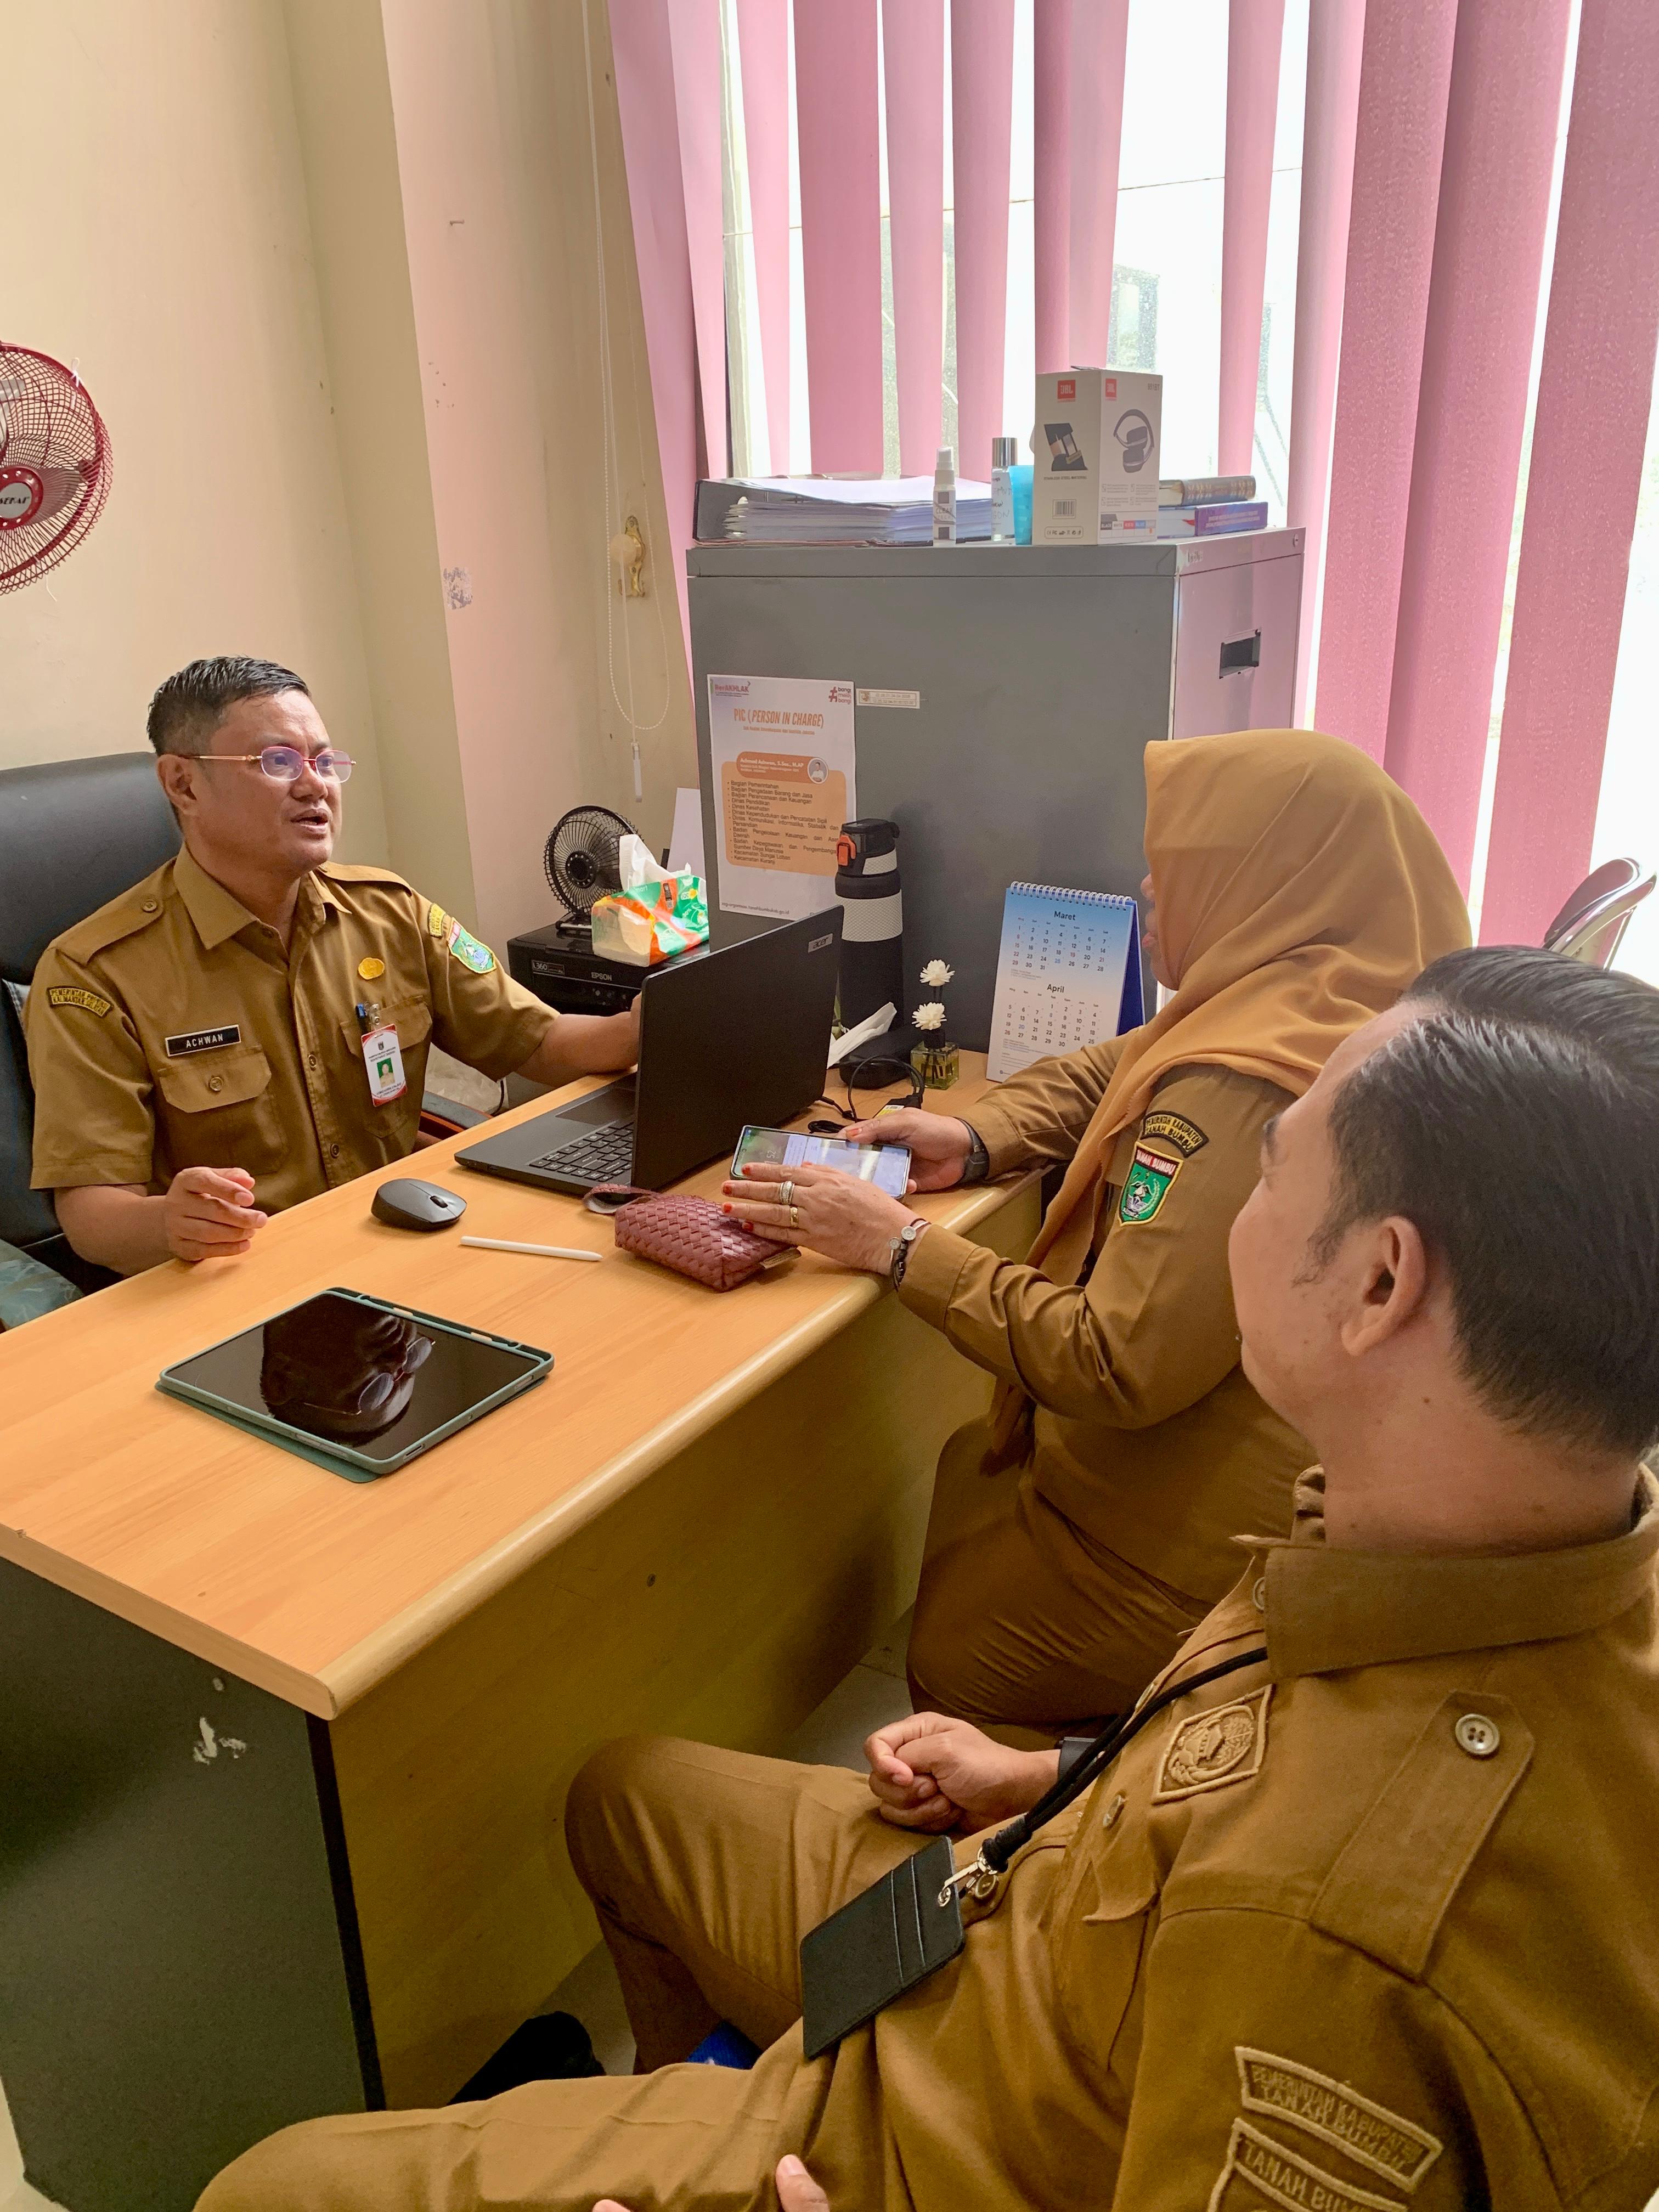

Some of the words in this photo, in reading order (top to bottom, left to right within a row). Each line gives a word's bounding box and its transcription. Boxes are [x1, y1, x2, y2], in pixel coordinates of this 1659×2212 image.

[1061, 385, 1073, 394] JBL
[734, 709, 746, 721] PIC
[782, 712, 791, 725] IN
[792, 713, 824, 728] CHARGE)
[1054, 911, 1076, 921] Maret
[813, 937, 828, 949] acer
[533, 962, 547, 970] L360
[591, 972, 612, 981] EPSON
[1047, 984, 1064, 993] April
[186, 1034, 223, 1048] ACHWAN
[1168, 1128, 1193, 1150] BUMBU
[1172, 1119, 1202, 1145] KABUPATEN
[1153, 1158, 1176, 1175] BUMBU
[1262, 2084, 1330, 2124] TANAH
[1333, 2115, 1406, 2170] BUMBU
[1338, 2099, 1424, 2164] KABUPATEN
[1244, 2140, 1308, 2201] TANAH
